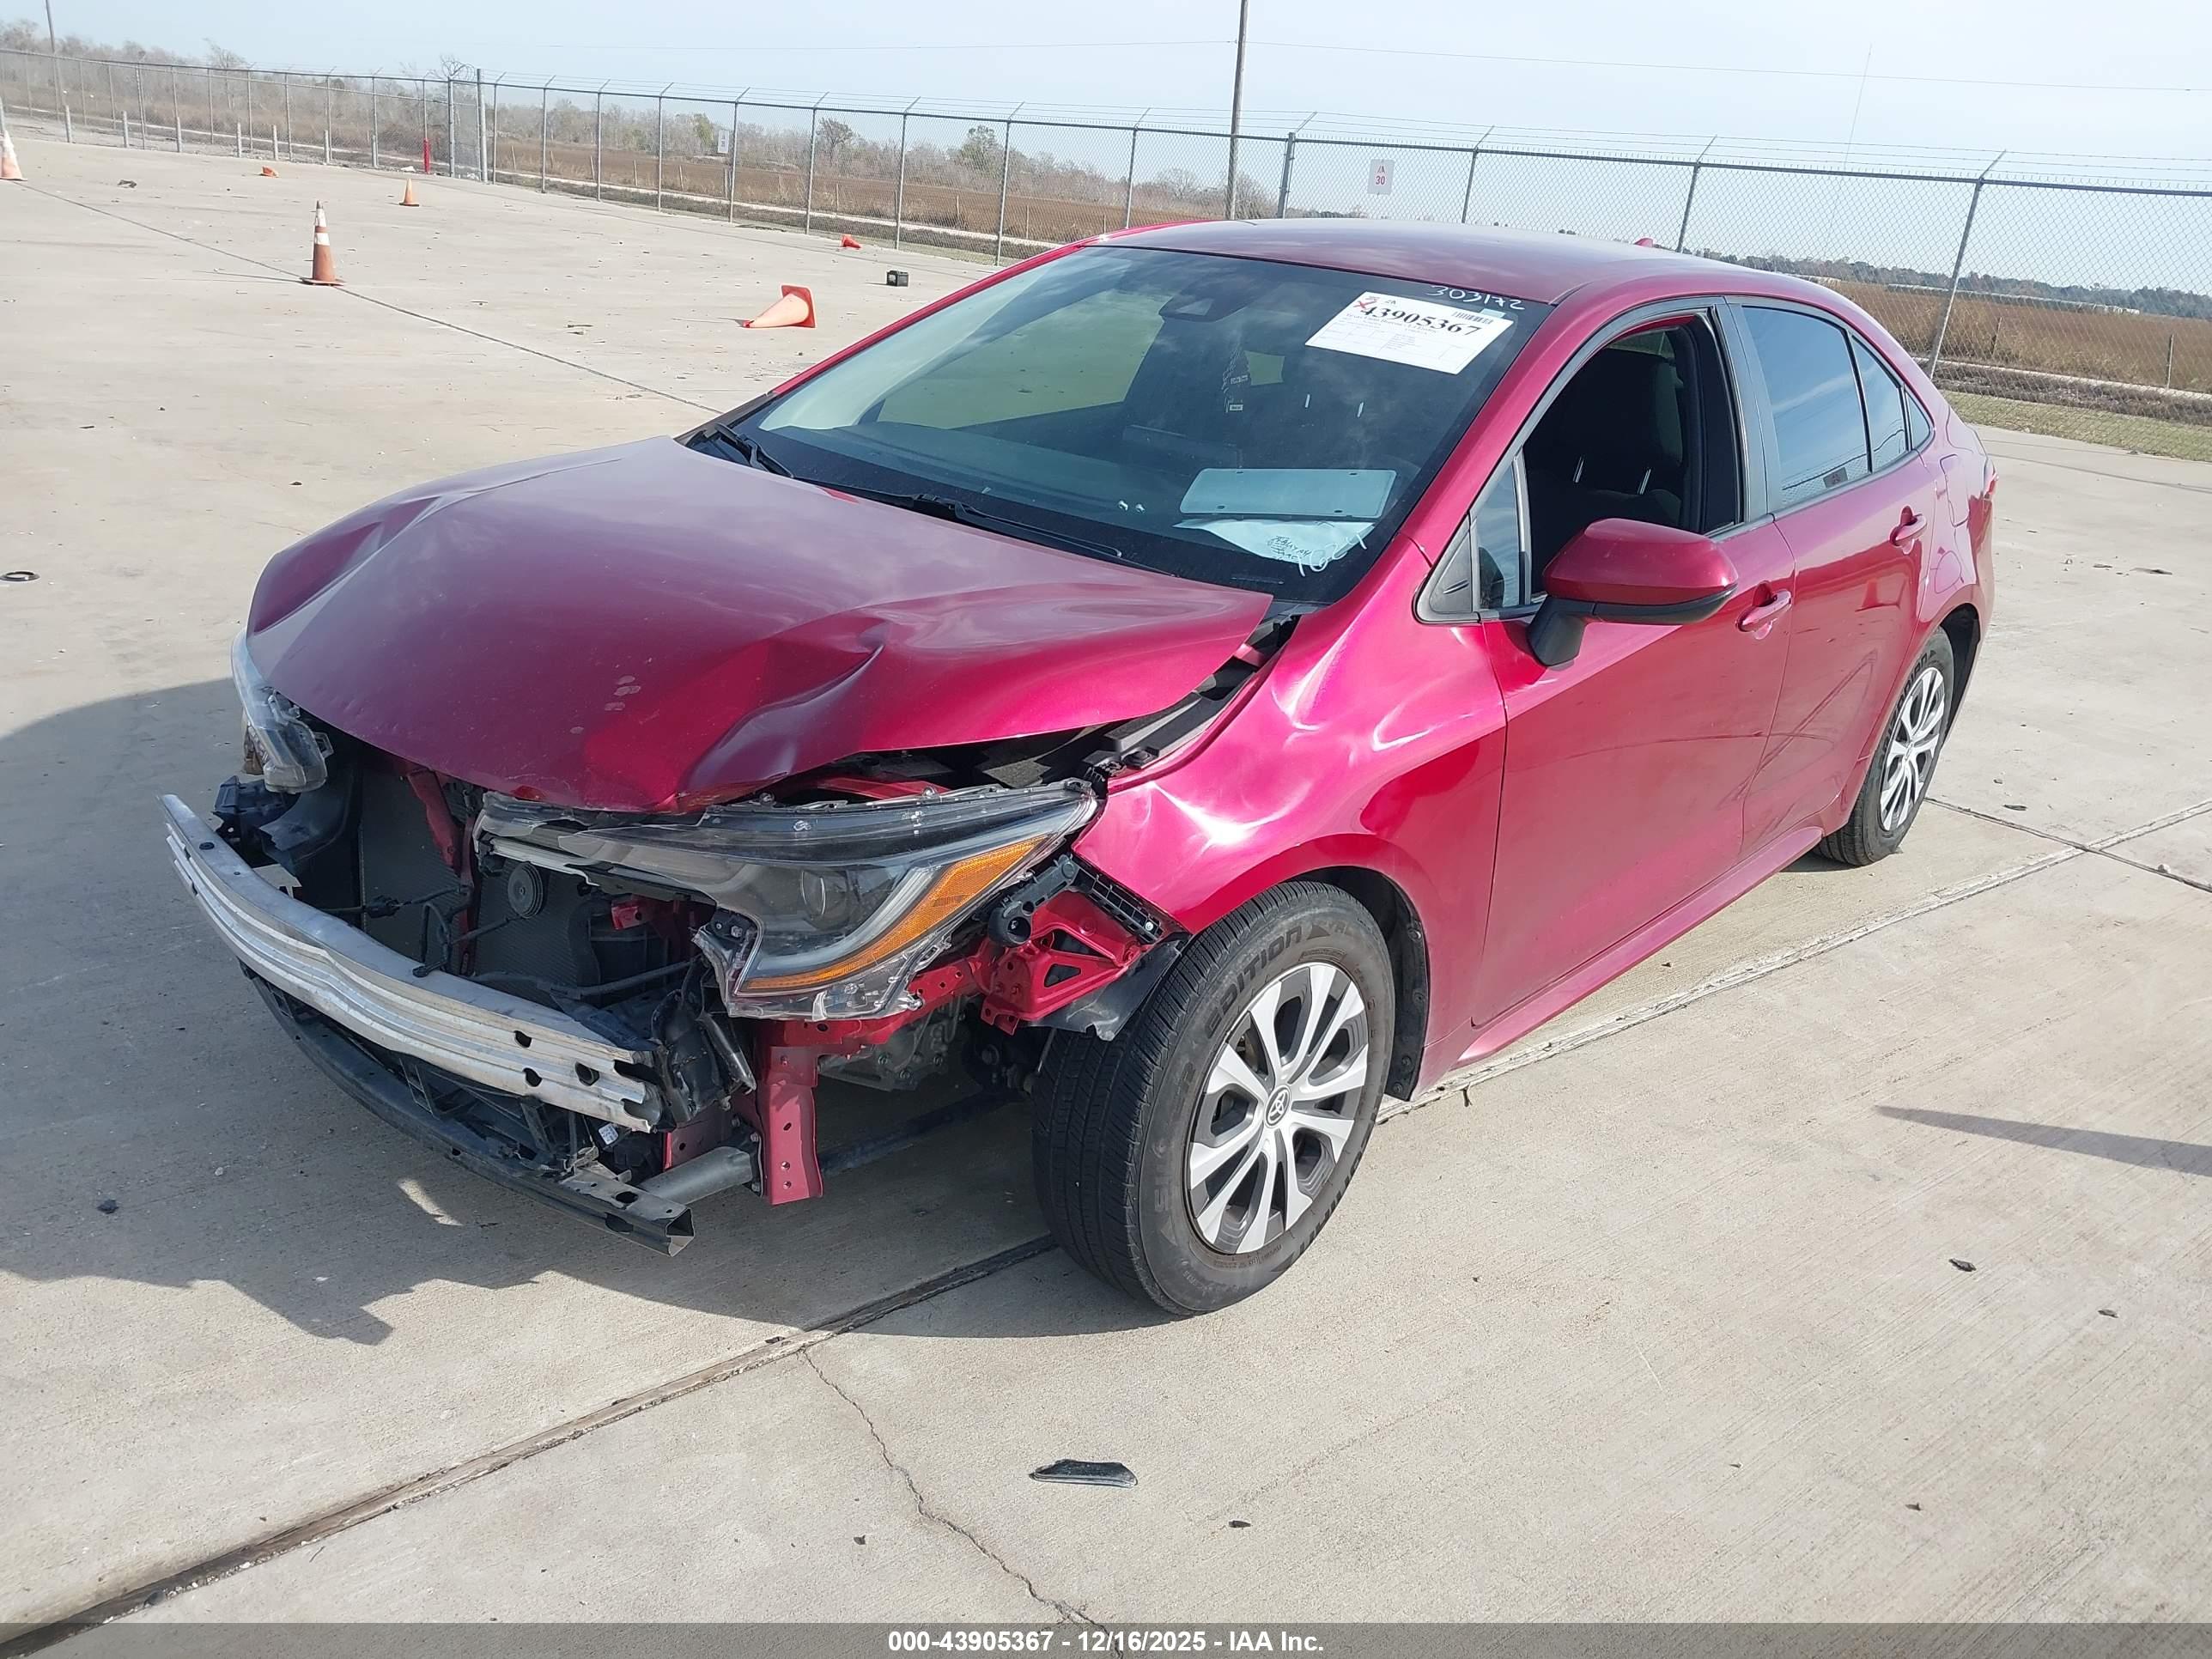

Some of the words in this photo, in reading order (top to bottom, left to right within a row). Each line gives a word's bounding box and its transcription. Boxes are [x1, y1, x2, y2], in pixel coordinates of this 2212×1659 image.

[1375, 175, 1386, 185] 30
[1359, 305, 1483, 337] 43905367
[1204, 925, 1304, 1039] EDITION
